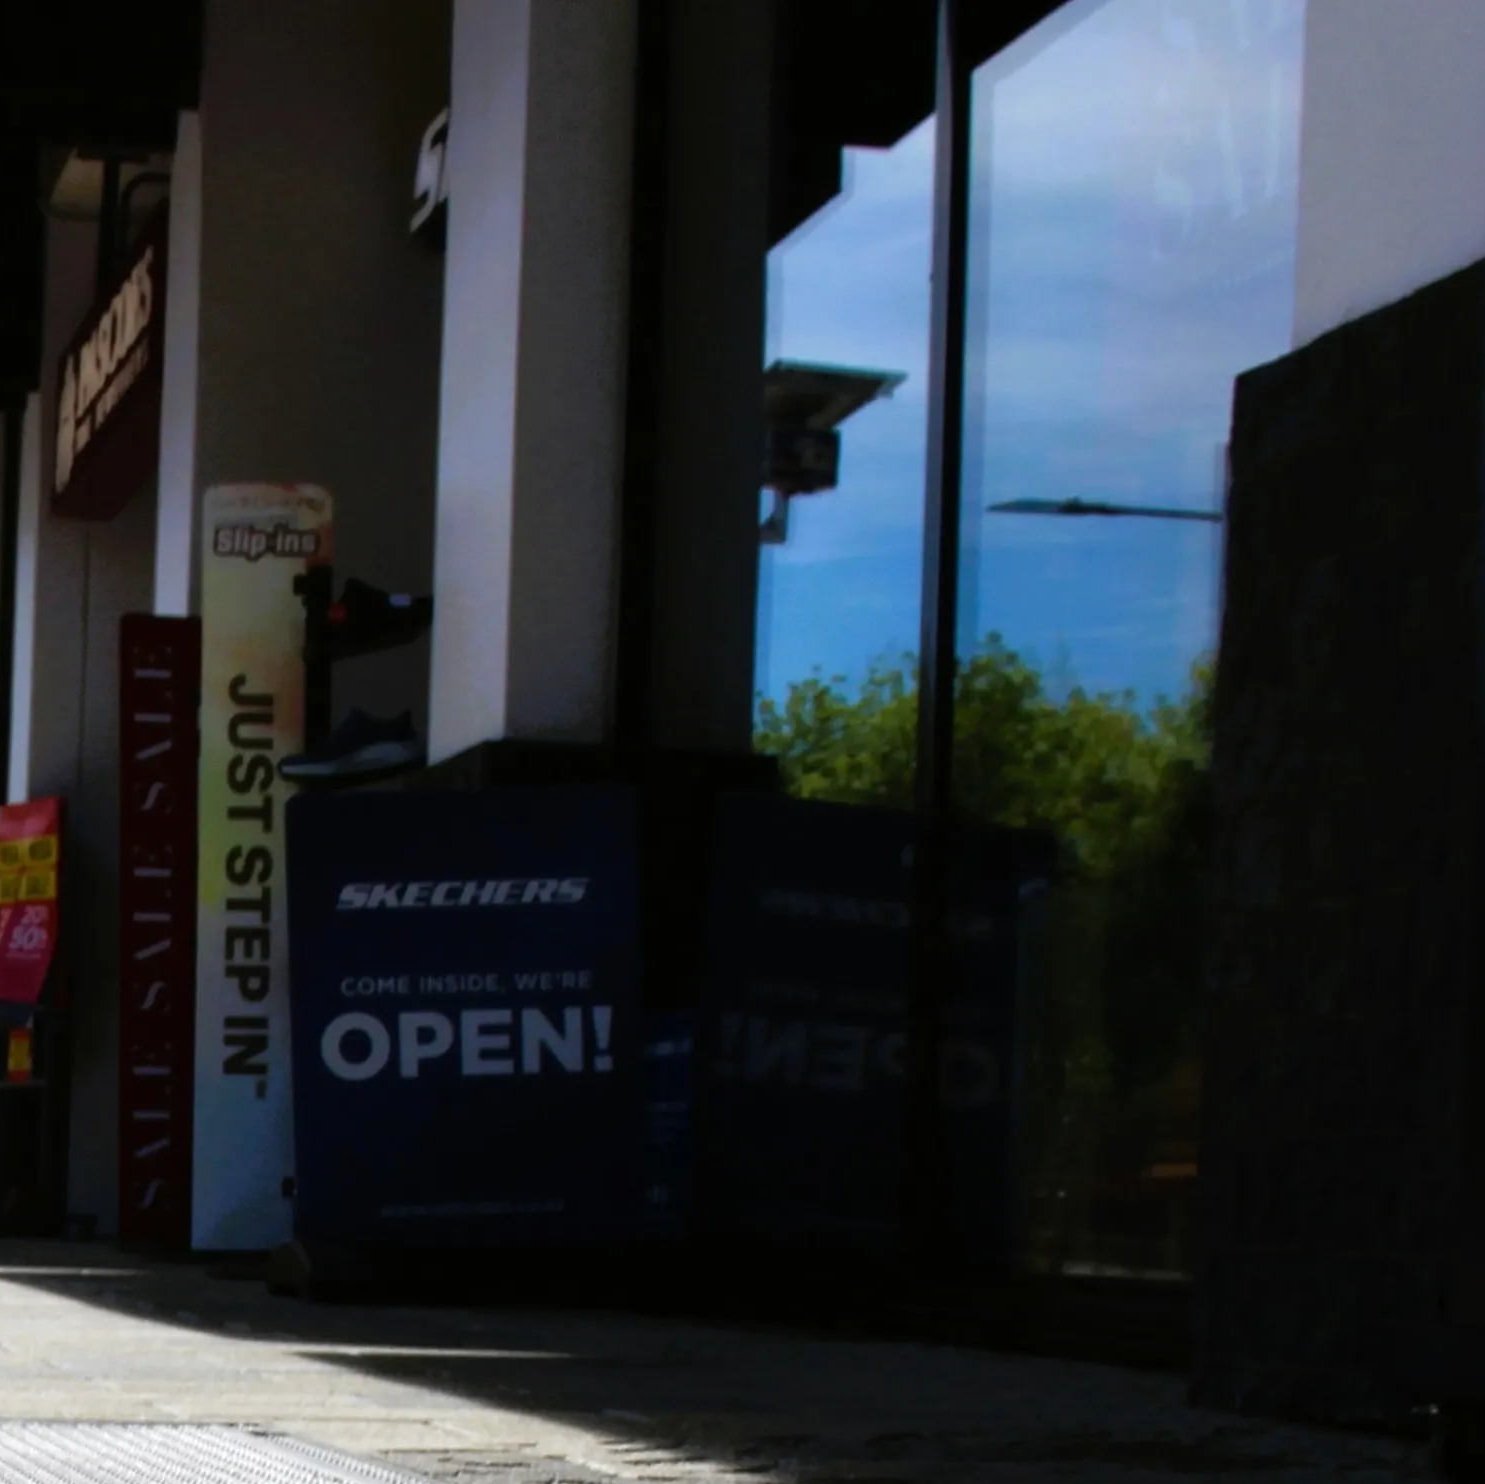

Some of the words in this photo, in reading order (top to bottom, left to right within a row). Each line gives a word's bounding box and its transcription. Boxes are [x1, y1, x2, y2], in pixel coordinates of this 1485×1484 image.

[226, 674, 275, 834] JUST
[224, 844, 274, 1003] STEP
[336, 876, 589, 910] SKECHERS
[340, 975, 412, 997] COME
[514, 970, 593, 992] WE'RE
[320, 1005, 614, 1081] OPEN!
